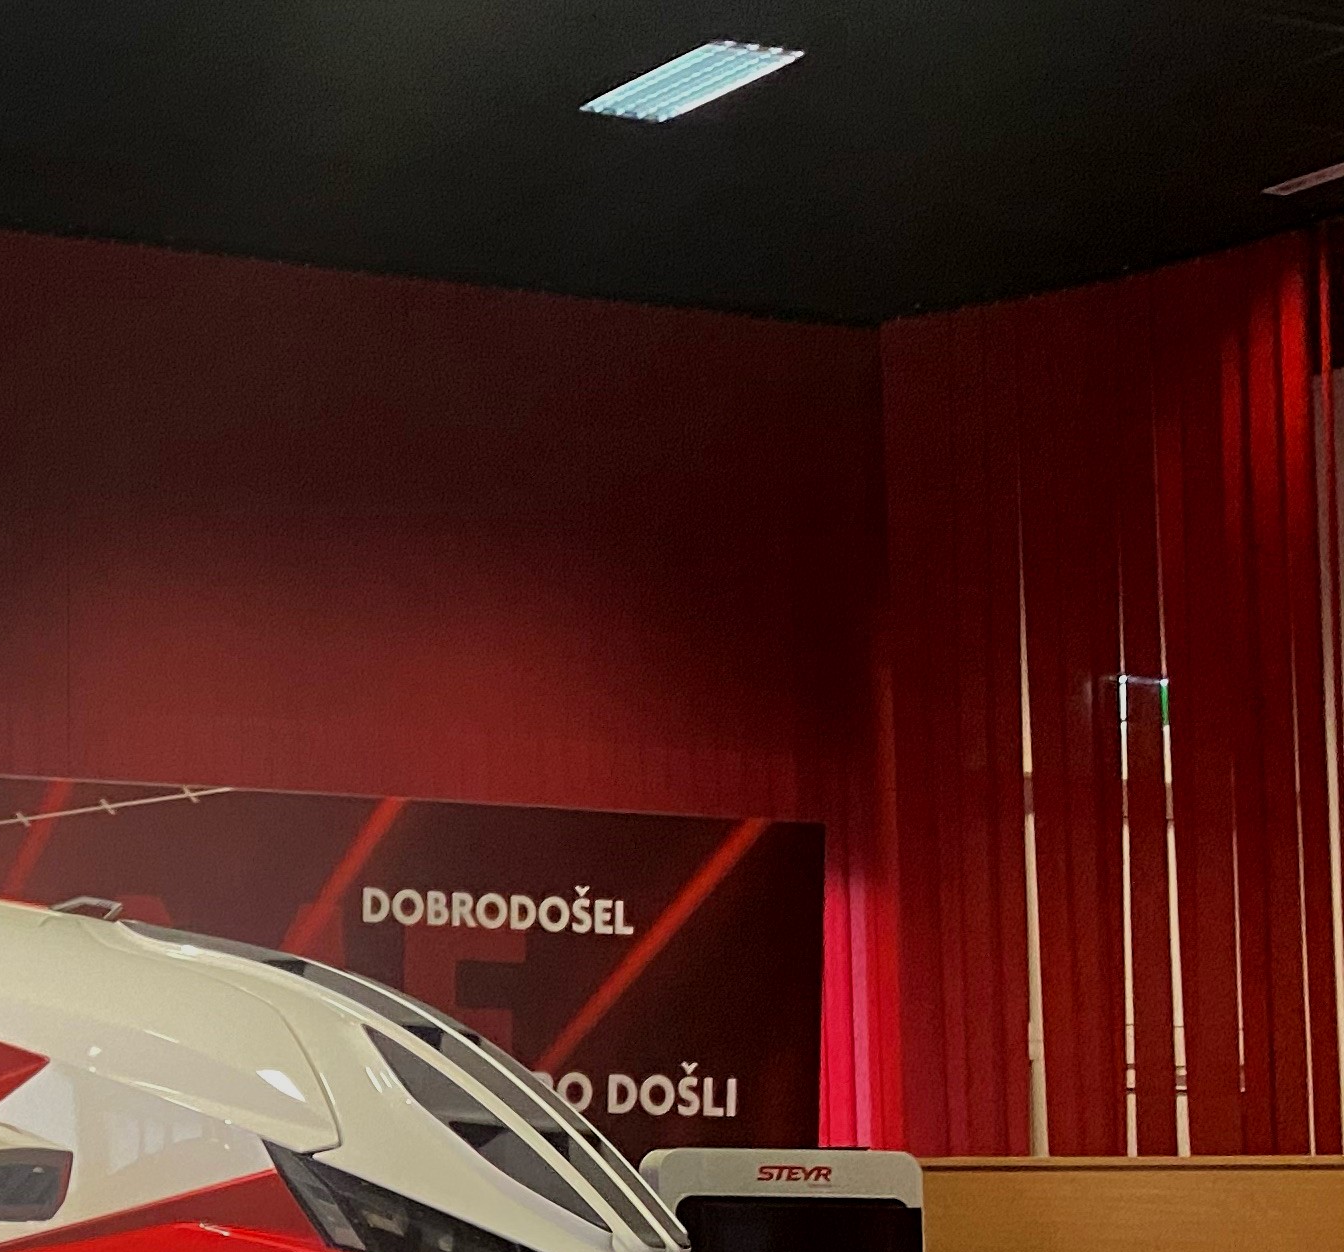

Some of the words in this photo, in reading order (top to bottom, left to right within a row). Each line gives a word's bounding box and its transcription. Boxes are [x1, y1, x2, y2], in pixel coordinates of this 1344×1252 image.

[362, 885, 634, 936] DOBRODOŠEL
[607, 1060, 738, 1118] DOŠLI
[757, 1165, 832, 1182] STEYR
